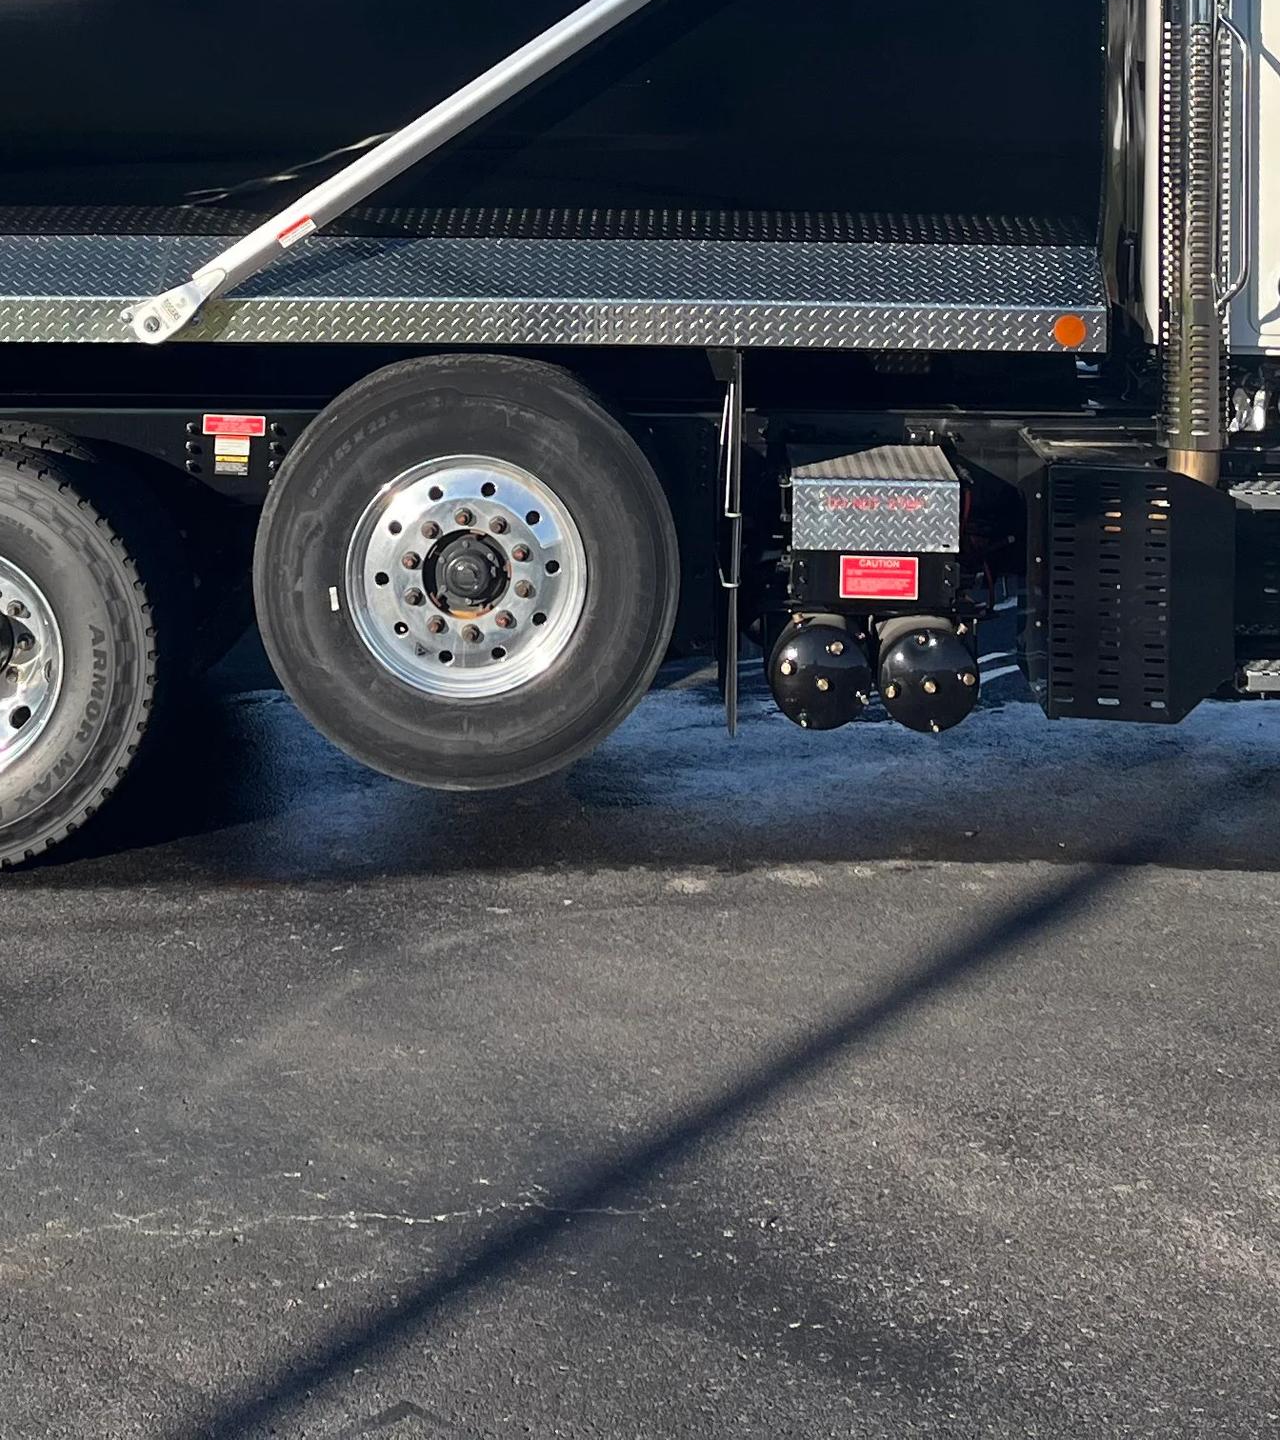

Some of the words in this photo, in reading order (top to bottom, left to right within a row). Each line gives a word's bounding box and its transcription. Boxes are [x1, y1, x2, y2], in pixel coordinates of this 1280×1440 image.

[858, 560, 901, 569] CAUTION
[75, 624, 108, 743] ARMOR
[14, 751, 76, 806] MAX
